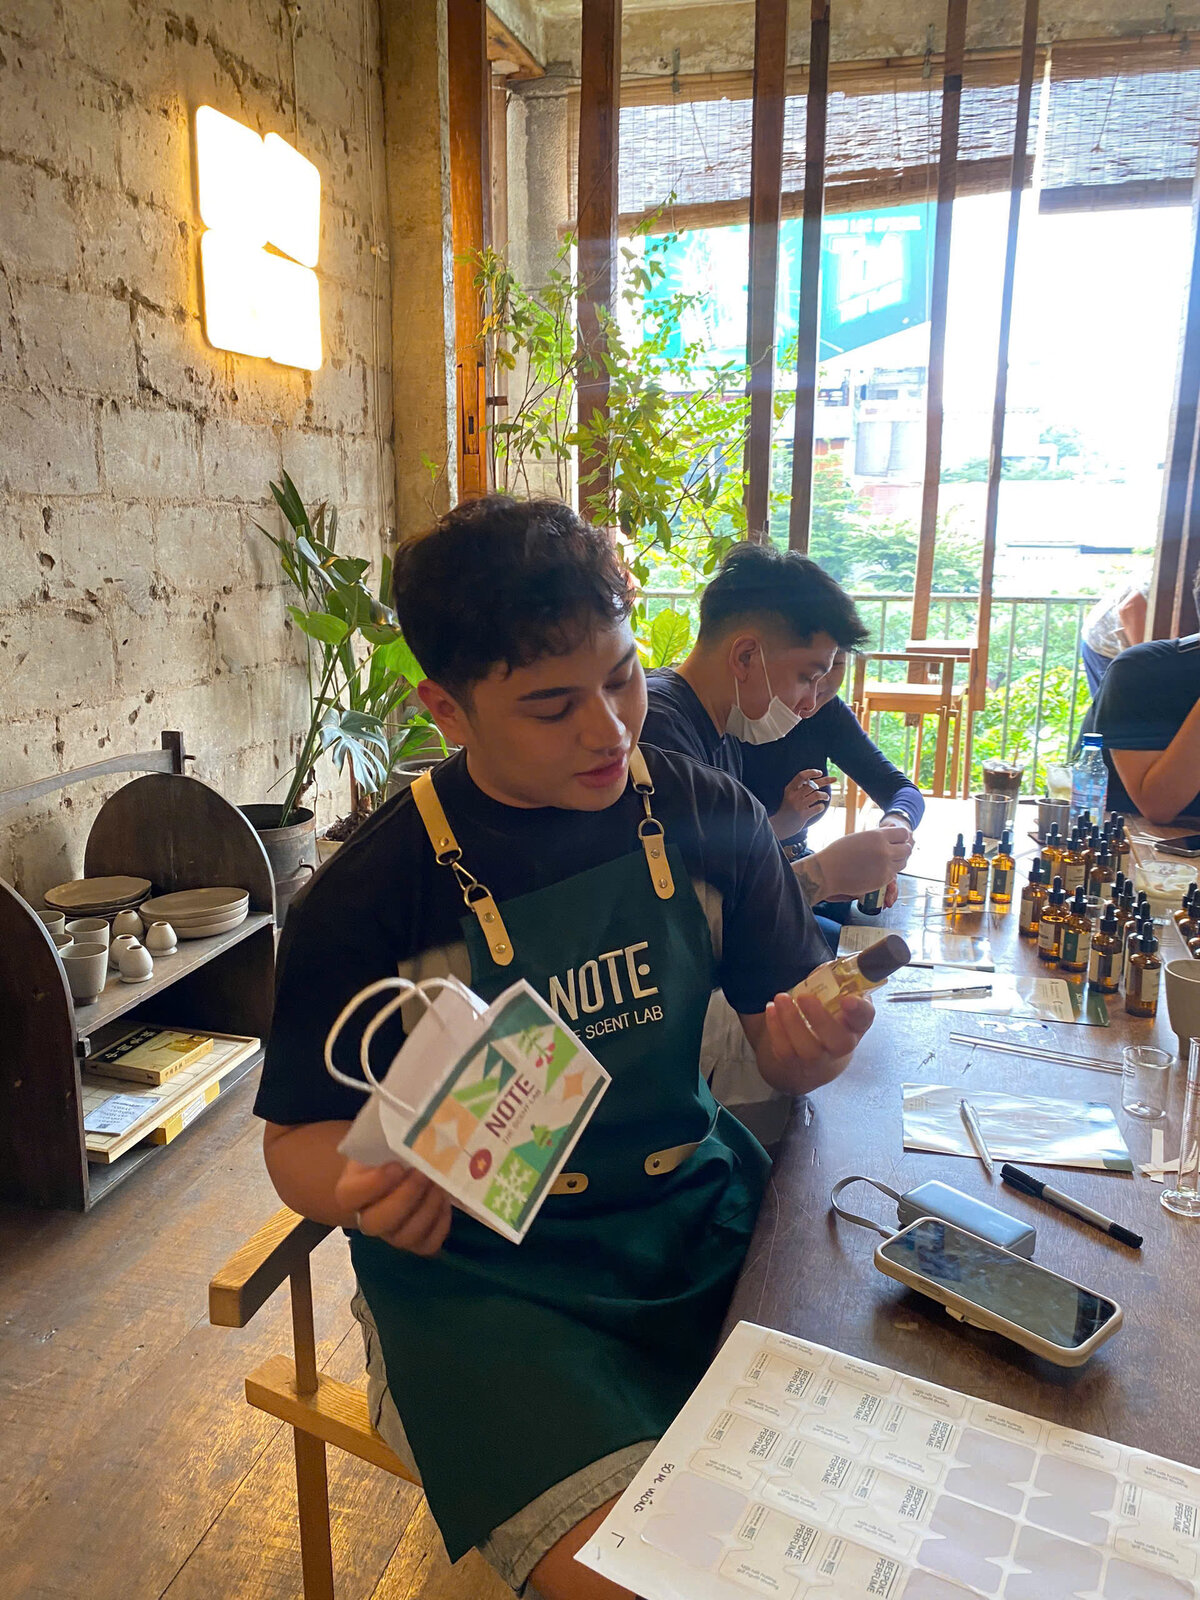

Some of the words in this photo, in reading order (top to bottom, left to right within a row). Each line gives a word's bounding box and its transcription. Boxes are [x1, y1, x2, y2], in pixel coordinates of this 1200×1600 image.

[549, 940, 659, 1021] NOTE
[585, 1012, 630, 1040] SCENT
[634, 1005, 664, 1025] LAB
[485, 1073, 535, 1138] NOTE
[784, 1367, 802, 1393] PERFUME
[792, 1370, 810, 1396] BESPOKE
[853, 1393, 870, 1420] PERFUME
[862, 1396, 878, 1423] BESPOKE
[749, 1427, 768, 1455] PERFUME
[756, 1431, 776, 1457] BESPOKE
[926, 1420, 942, 1447] PERFUME
[934, 1422, 950, 1450] BESPOKE
[820, 1455, 840, 1484] PERFUME
[829, 1458, 848, 1487] BESPOKE
[898, 1484, 916, 1515] PERFUME
[906, 1486, 925, 1518] BESPOKE
[784, 1523, 806, 1559] PERFUME
[793, 1527, 814, 1560] BESPOKE
[866, 1557, 886, 1594] PERFUME
[875, 1560, 895, 1597] BESPOKE
